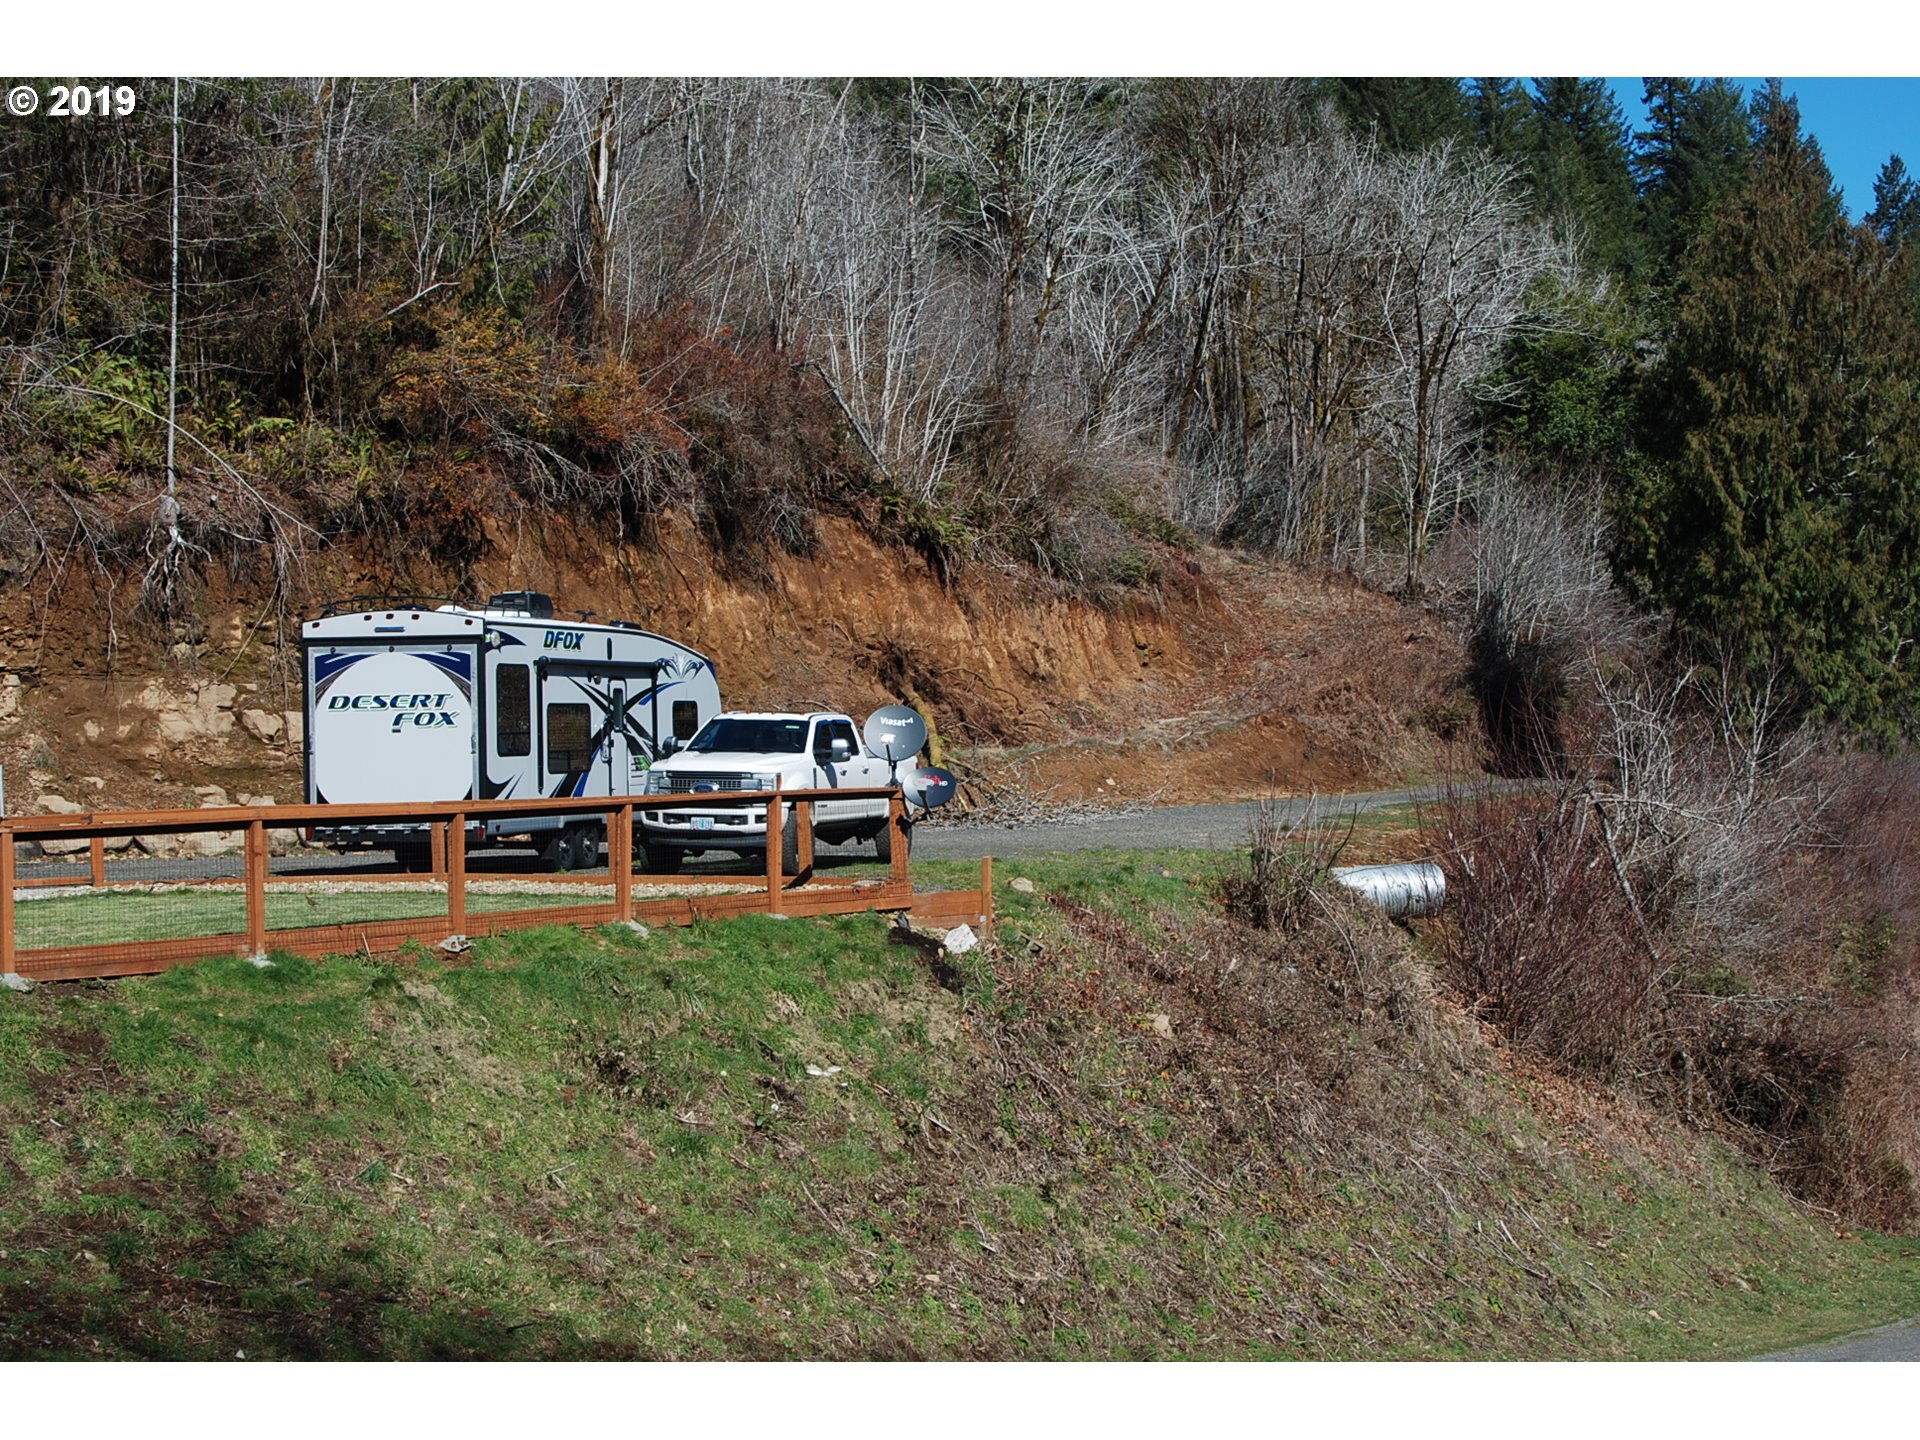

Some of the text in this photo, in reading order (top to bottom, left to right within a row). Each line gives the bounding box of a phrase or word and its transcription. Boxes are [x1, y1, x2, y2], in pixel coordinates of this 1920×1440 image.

[543, 630, 585, 651] DFOX
[328, 694, 453, 711] DESERT
[392, 712, 459, 728] FOX
[880, 716, 908, 727] Viasat
